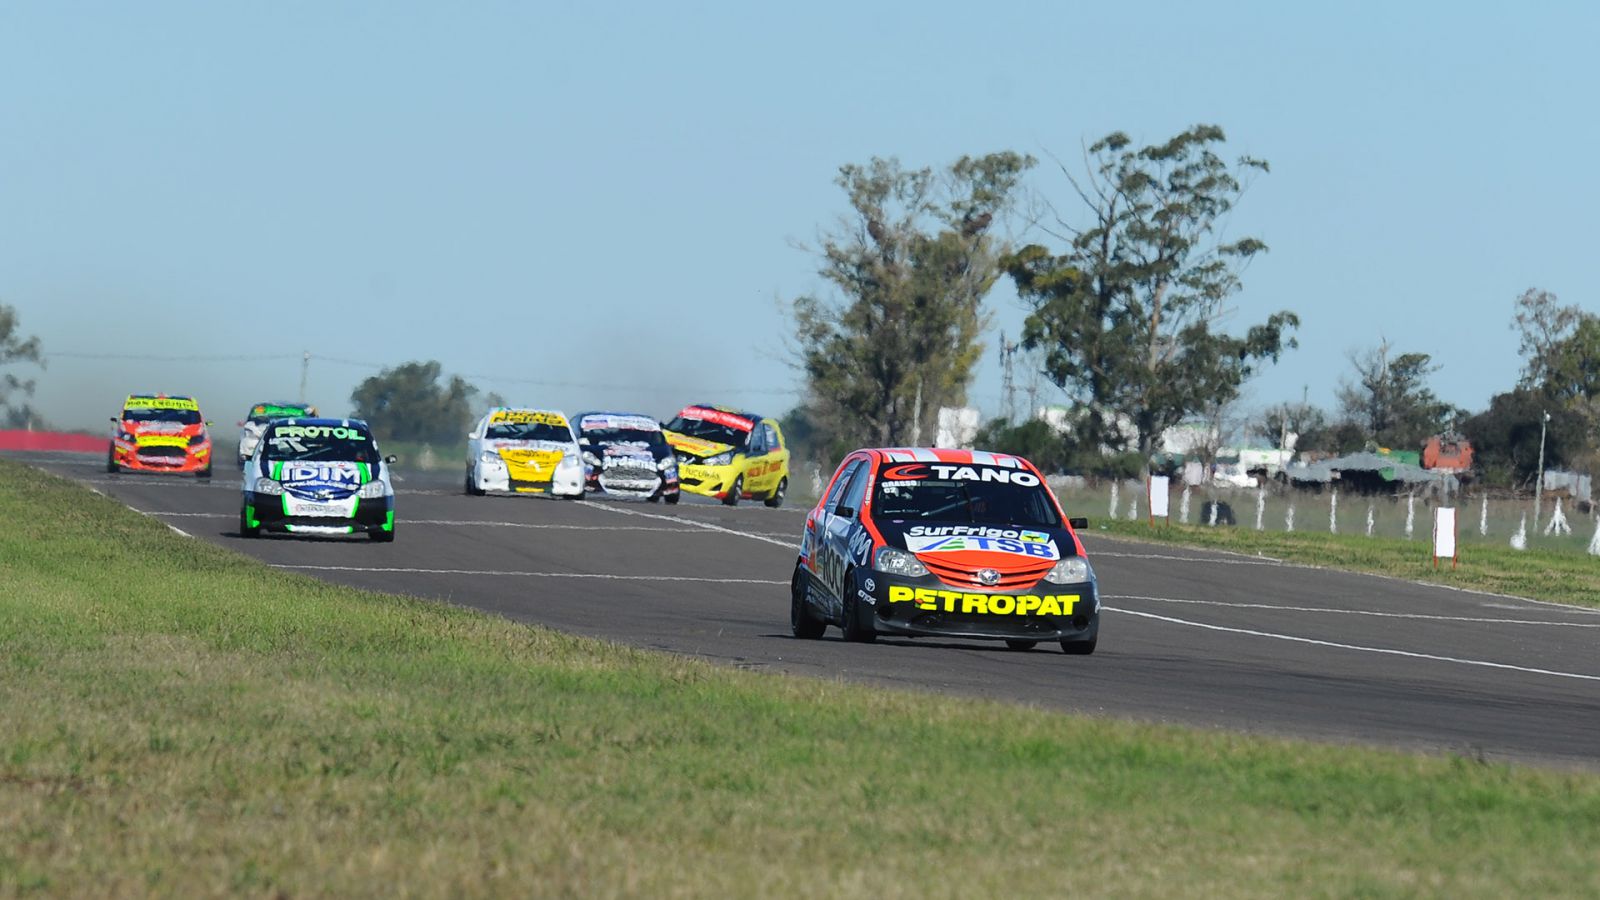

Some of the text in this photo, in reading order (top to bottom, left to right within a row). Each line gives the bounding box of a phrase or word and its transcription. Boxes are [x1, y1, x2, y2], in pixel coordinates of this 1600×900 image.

[275, 426, 366, 440] PROTOIL
[281, 467, 360, 484] IDIM
[910, 526, 1018, 539] SurFrigo
[967, 537, 1054, 558] TSB
[889, 586, 1080, 616] PETROPAT
